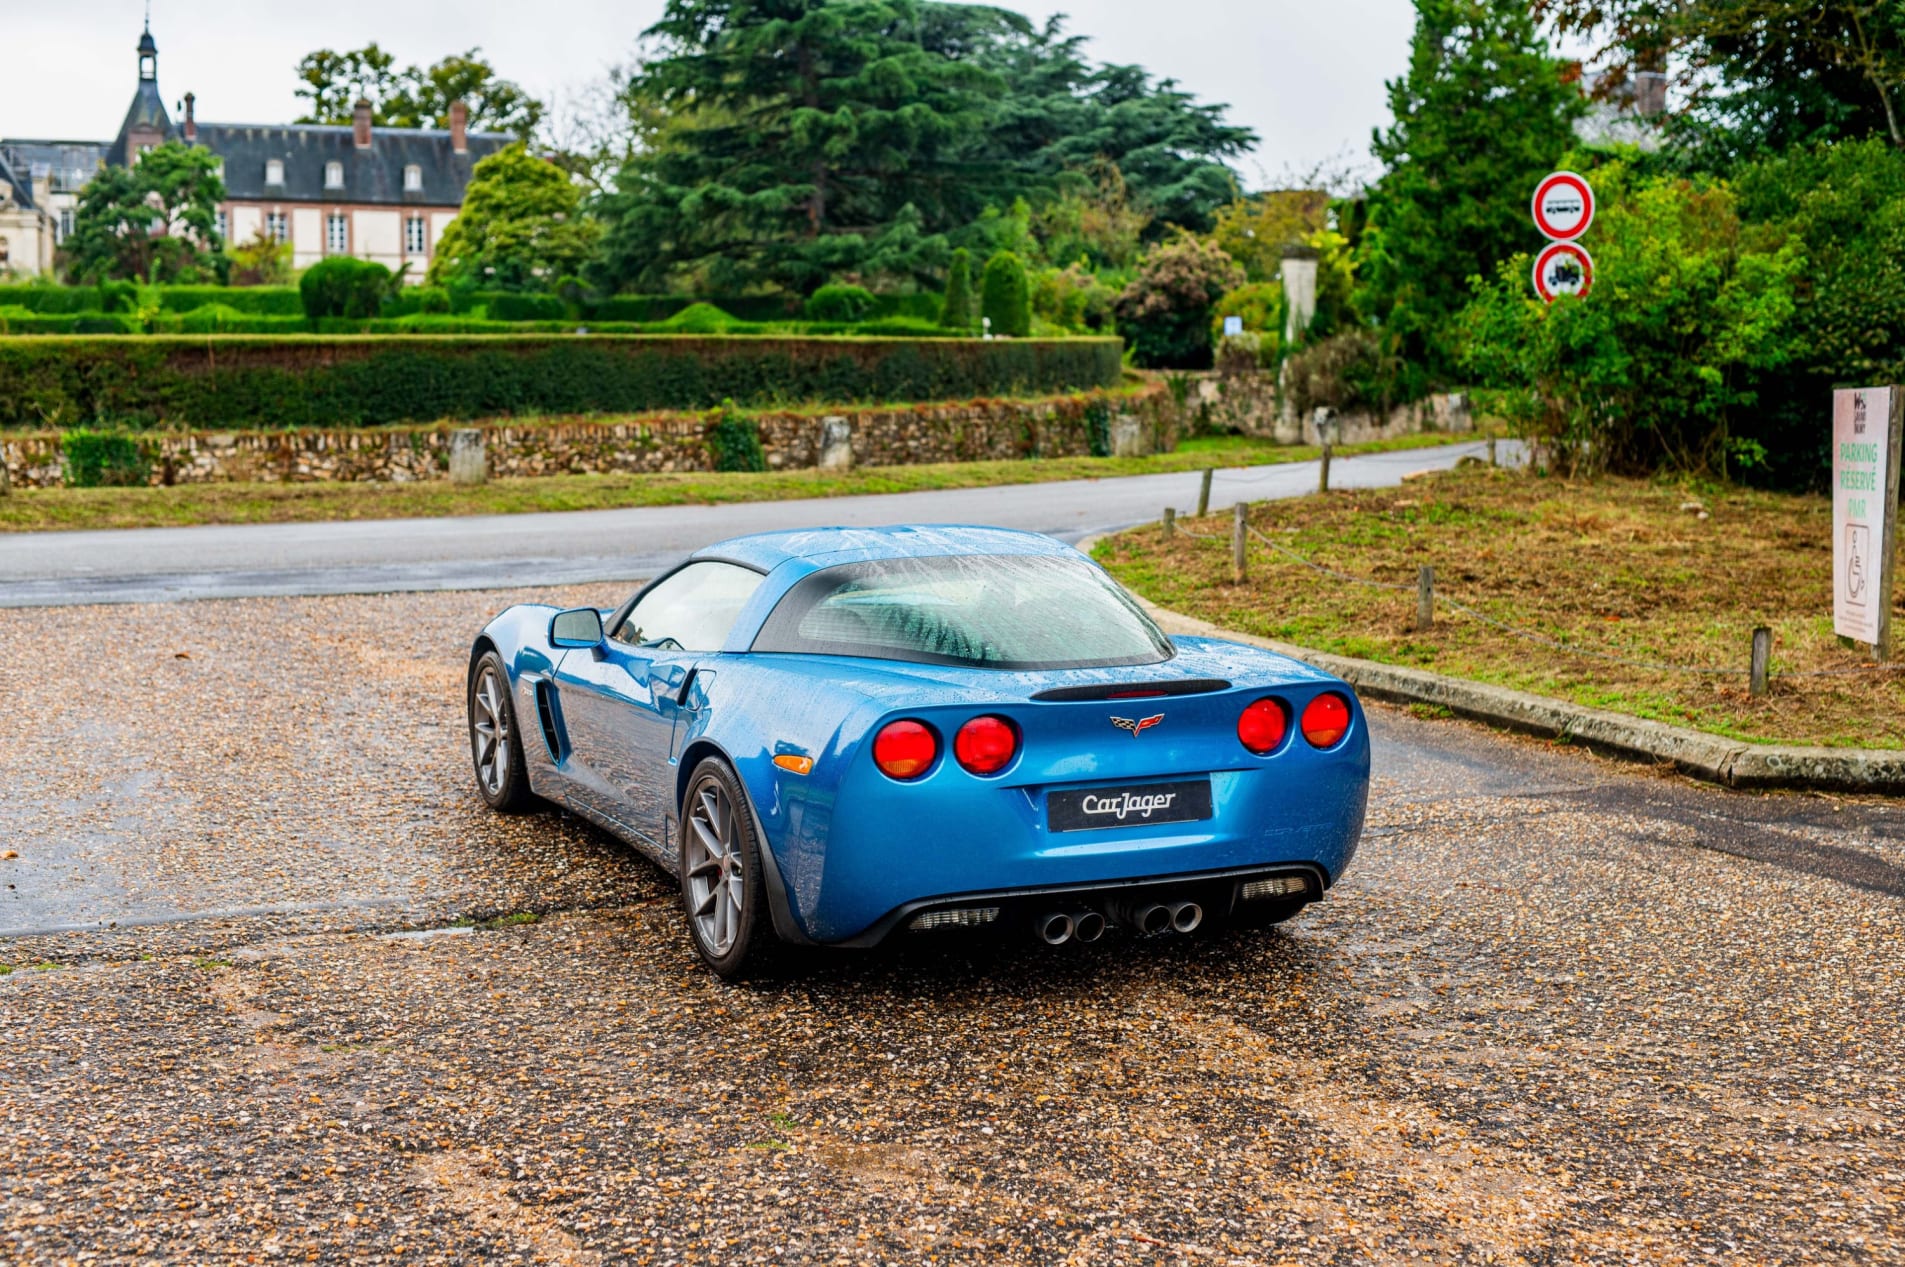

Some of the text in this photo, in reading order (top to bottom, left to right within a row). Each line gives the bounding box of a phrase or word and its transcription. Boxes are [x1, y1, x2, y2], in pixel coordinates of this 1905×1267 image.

[1840, 443, 1877, 463] PARKING
[1840, 465, 1876, 491] RÉSERVÉ
[1848, 498, 1866, 518] PMR
[1082, 792, 1176, 819] CarJager
